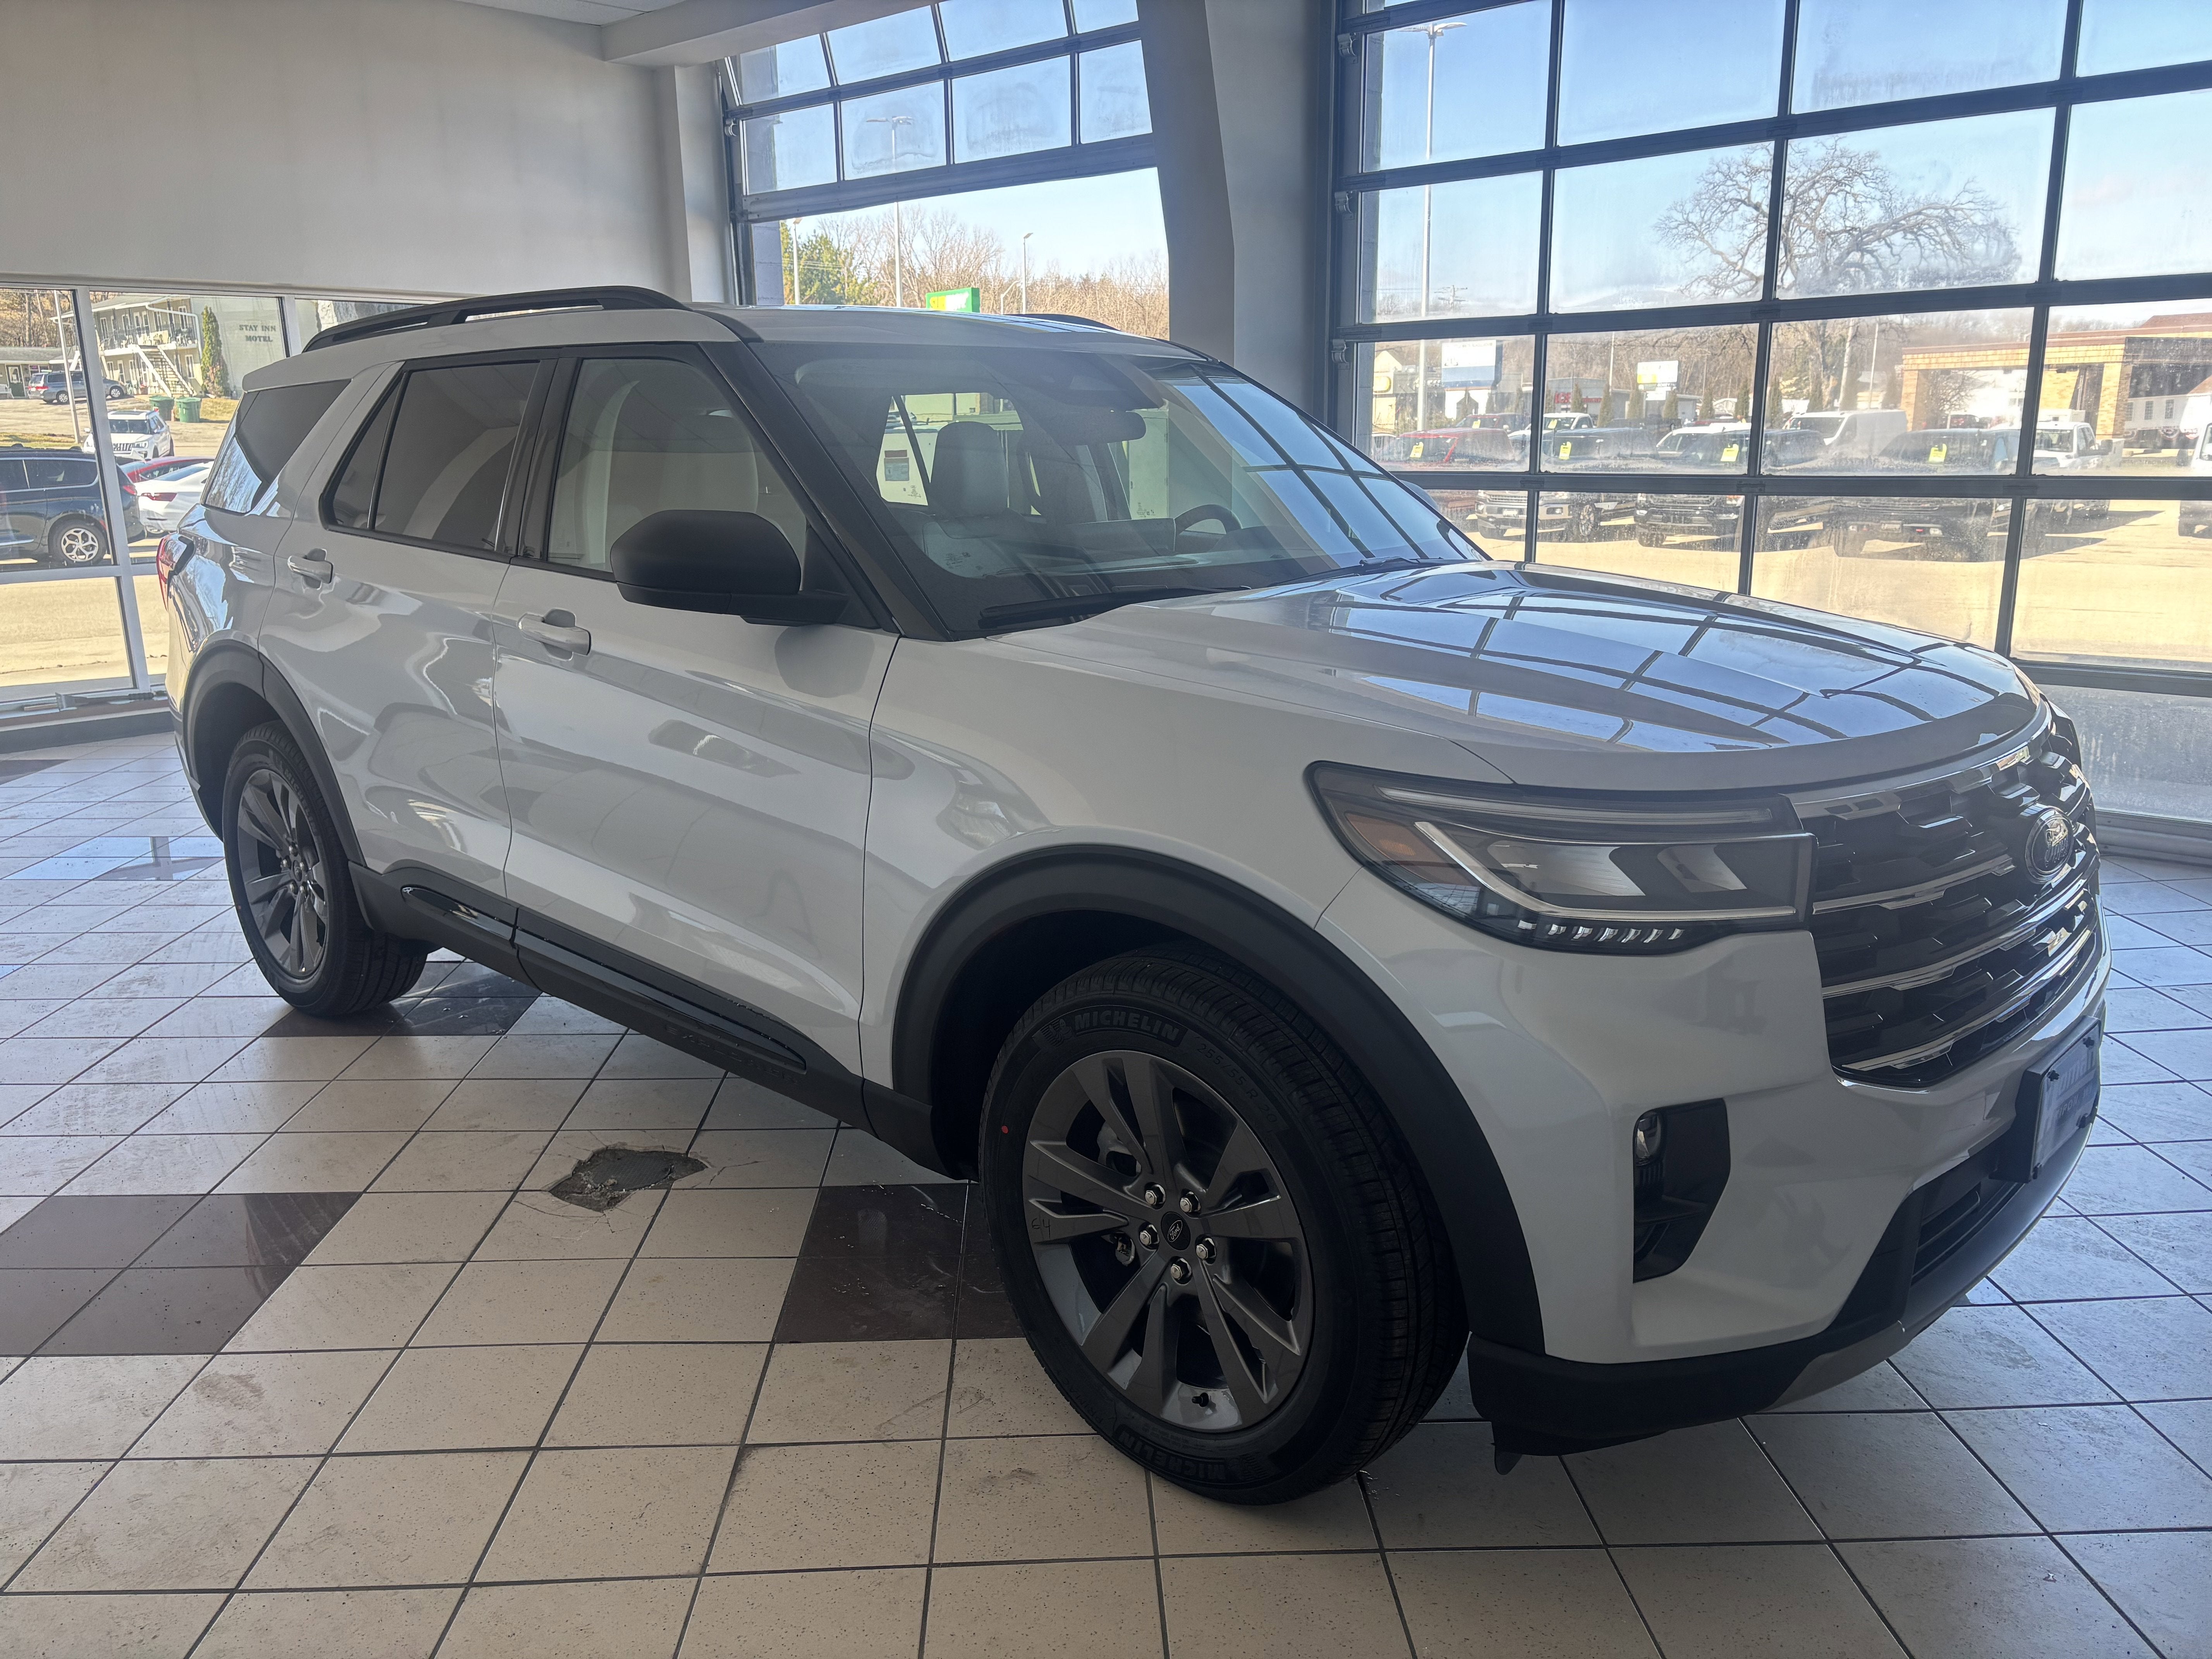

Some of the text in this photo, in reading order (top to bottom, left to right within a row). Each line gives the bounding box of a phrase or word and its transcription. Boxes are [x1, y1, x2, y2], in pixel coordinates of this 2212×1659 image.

[1075, 1010, 1180, 1041] MICHELIN
[1197, 1043, 1247, 1085] 255/55
[1258, 1104, 1278, 1123] 20
[1169, 1223, 1181, 1240] Ford
[1118, 1430, 1226, 1480] MICHELIN
